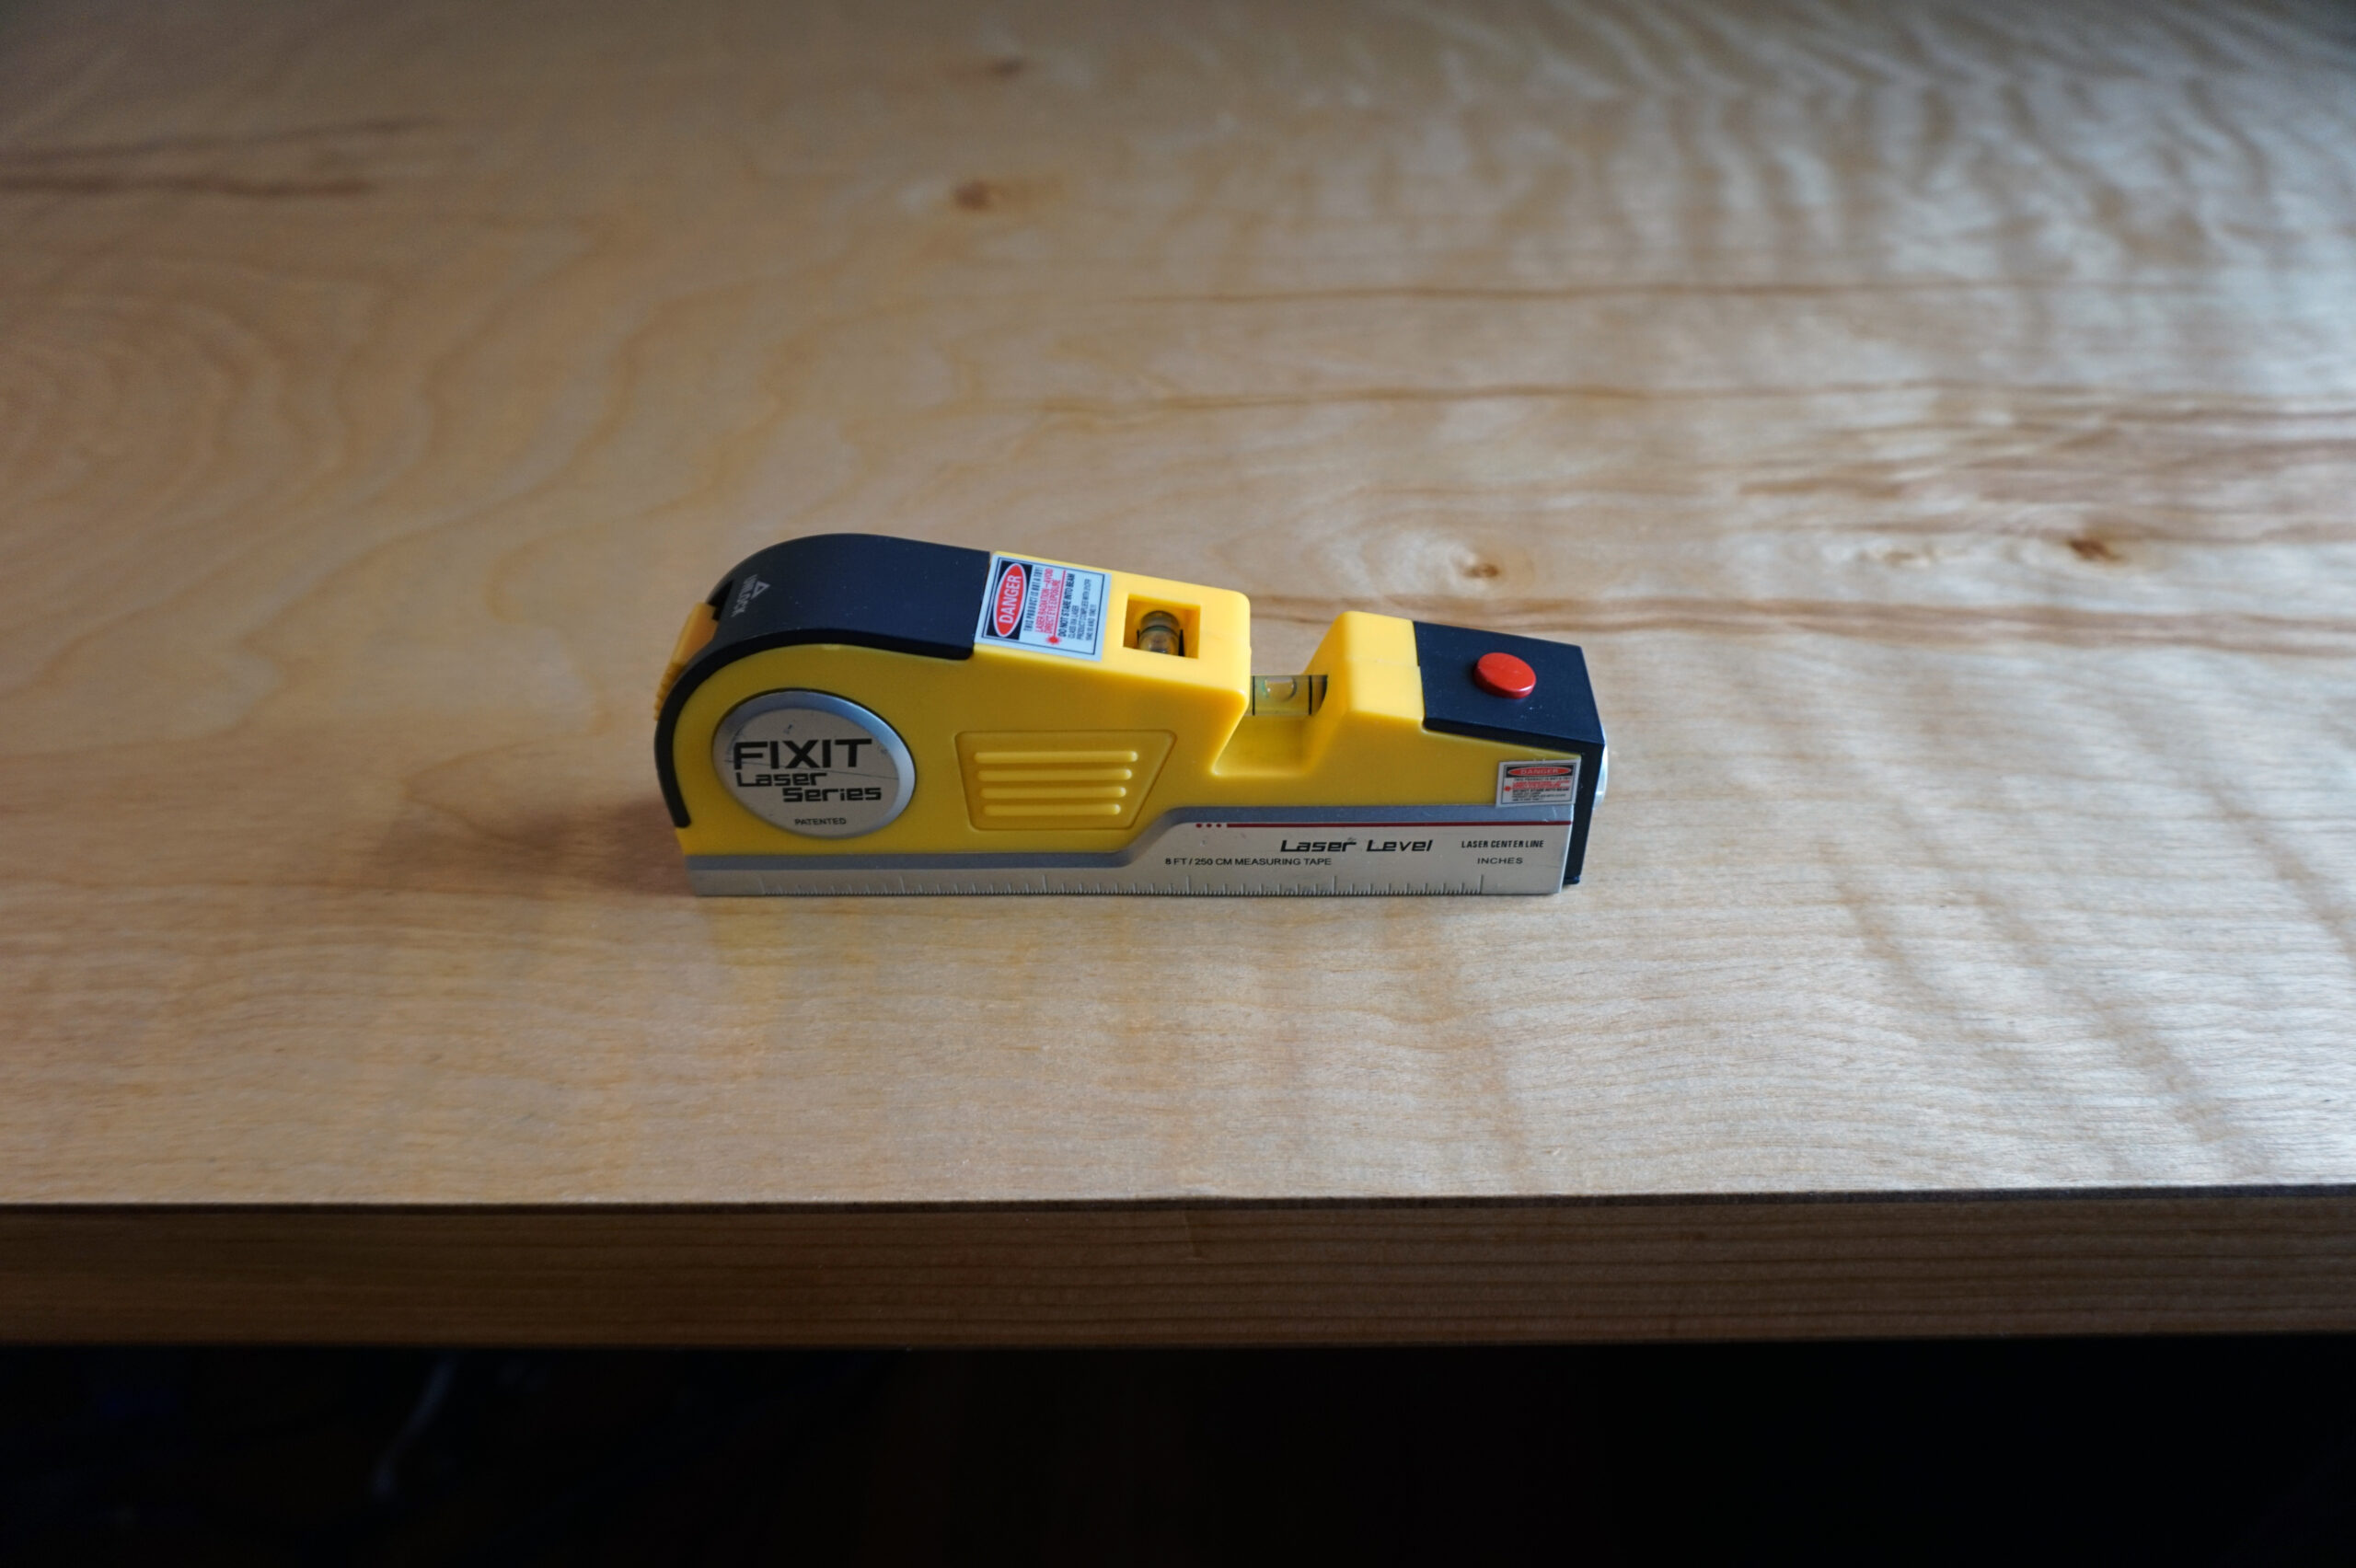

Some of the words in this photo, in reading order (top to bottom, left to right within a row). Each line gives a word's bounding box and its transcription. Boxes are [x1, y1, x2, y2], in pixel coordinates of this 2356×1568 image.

[1066, 573, 1075, 587] BEAM
[999, 575, 1022, 624] DANGER
[1048, 579, 1060, 604] EXPOSURE
[1064, 587, 1073, 600] INTO
[1025, 597, 1037, 619] PRODUCT
[1037, 588, 1050, 616] RADIATION
[1046, 605, 1057, 615] EYE
[1061, 600, 1071, 617] STARE
[1034, 616, 1045, 632] LASER
[1044, 616, 1055, 634] DIRECT
[1059, 617, 1068, 628] NOT
[1058, 628, 1067, 637] DO
[733, 739, 872, 770] FIXIT
[736, 770, 827, 787] Laser
[783, 788, 882, 802] Series
[1280, 840, 1357, 852] Laser
[1366, 840, 1433, 852] Level
